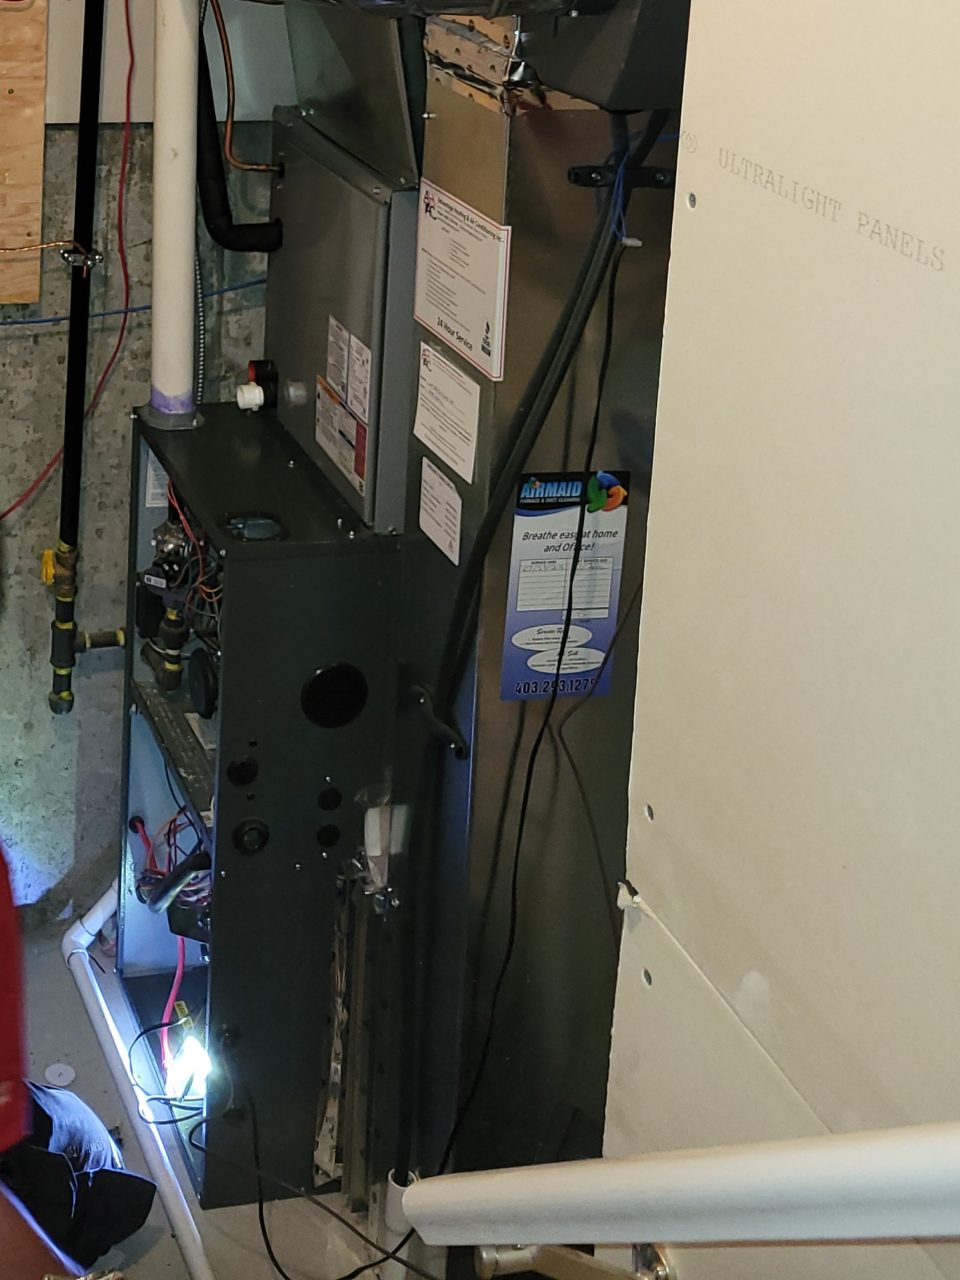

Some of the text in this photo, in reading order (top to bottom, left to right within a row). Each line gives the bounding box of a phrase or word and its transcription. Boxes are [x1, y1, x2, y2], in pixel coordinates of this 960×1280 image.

[718, 147, 945, 272] ULTRALIGHT PANELS
[443, 322, 456, 338] Hour
[455, 331, 473, 352] Service
[520, 481, 583, 499] AIRMAID
[522, 531, 557, 541] Breathe
[592, 529, 619, 539] home
[543, 542, 561, 553] and
